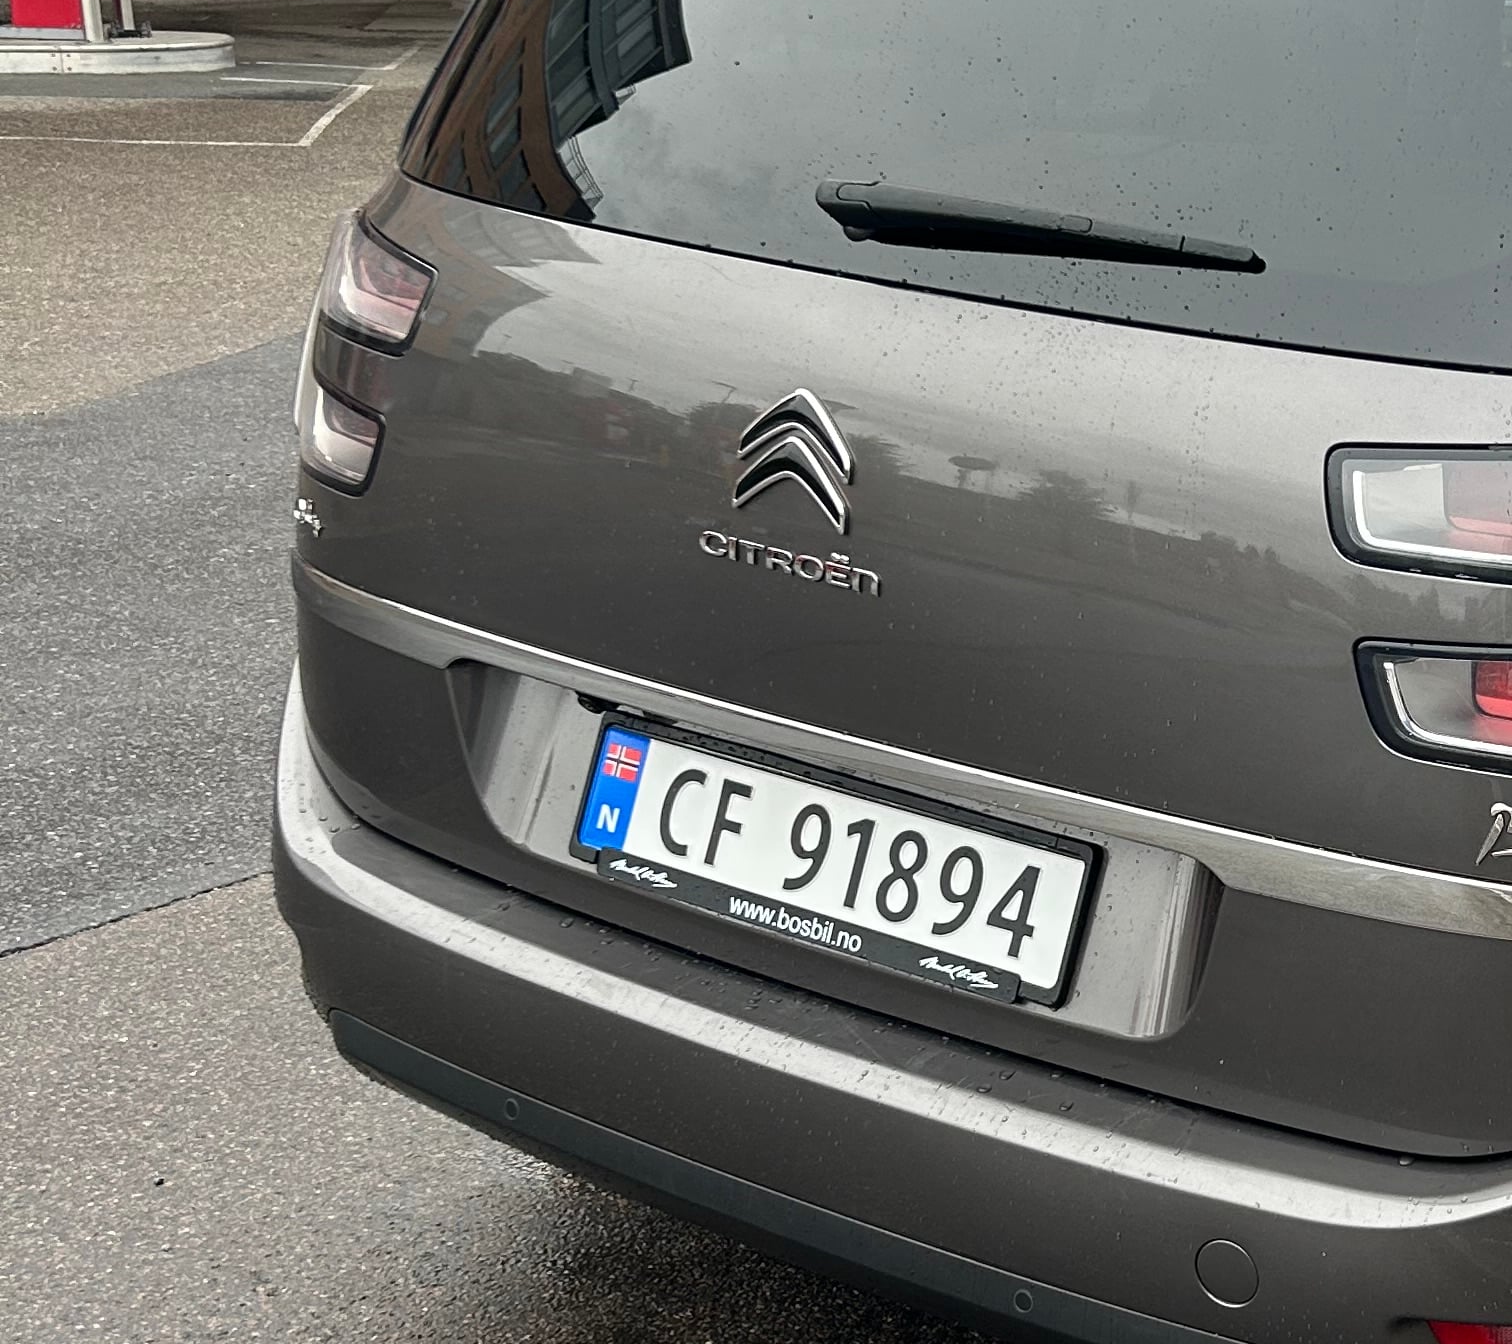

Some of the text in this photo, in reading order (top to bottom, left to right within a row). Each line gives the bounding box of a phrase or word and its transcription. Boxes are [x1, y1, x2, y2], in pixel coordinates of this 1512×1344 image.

[595, 803, 618, 834] N
[659, 768, 1044, 960] CF 91894
[729, 895, 862, 953] www.bosbil.no
